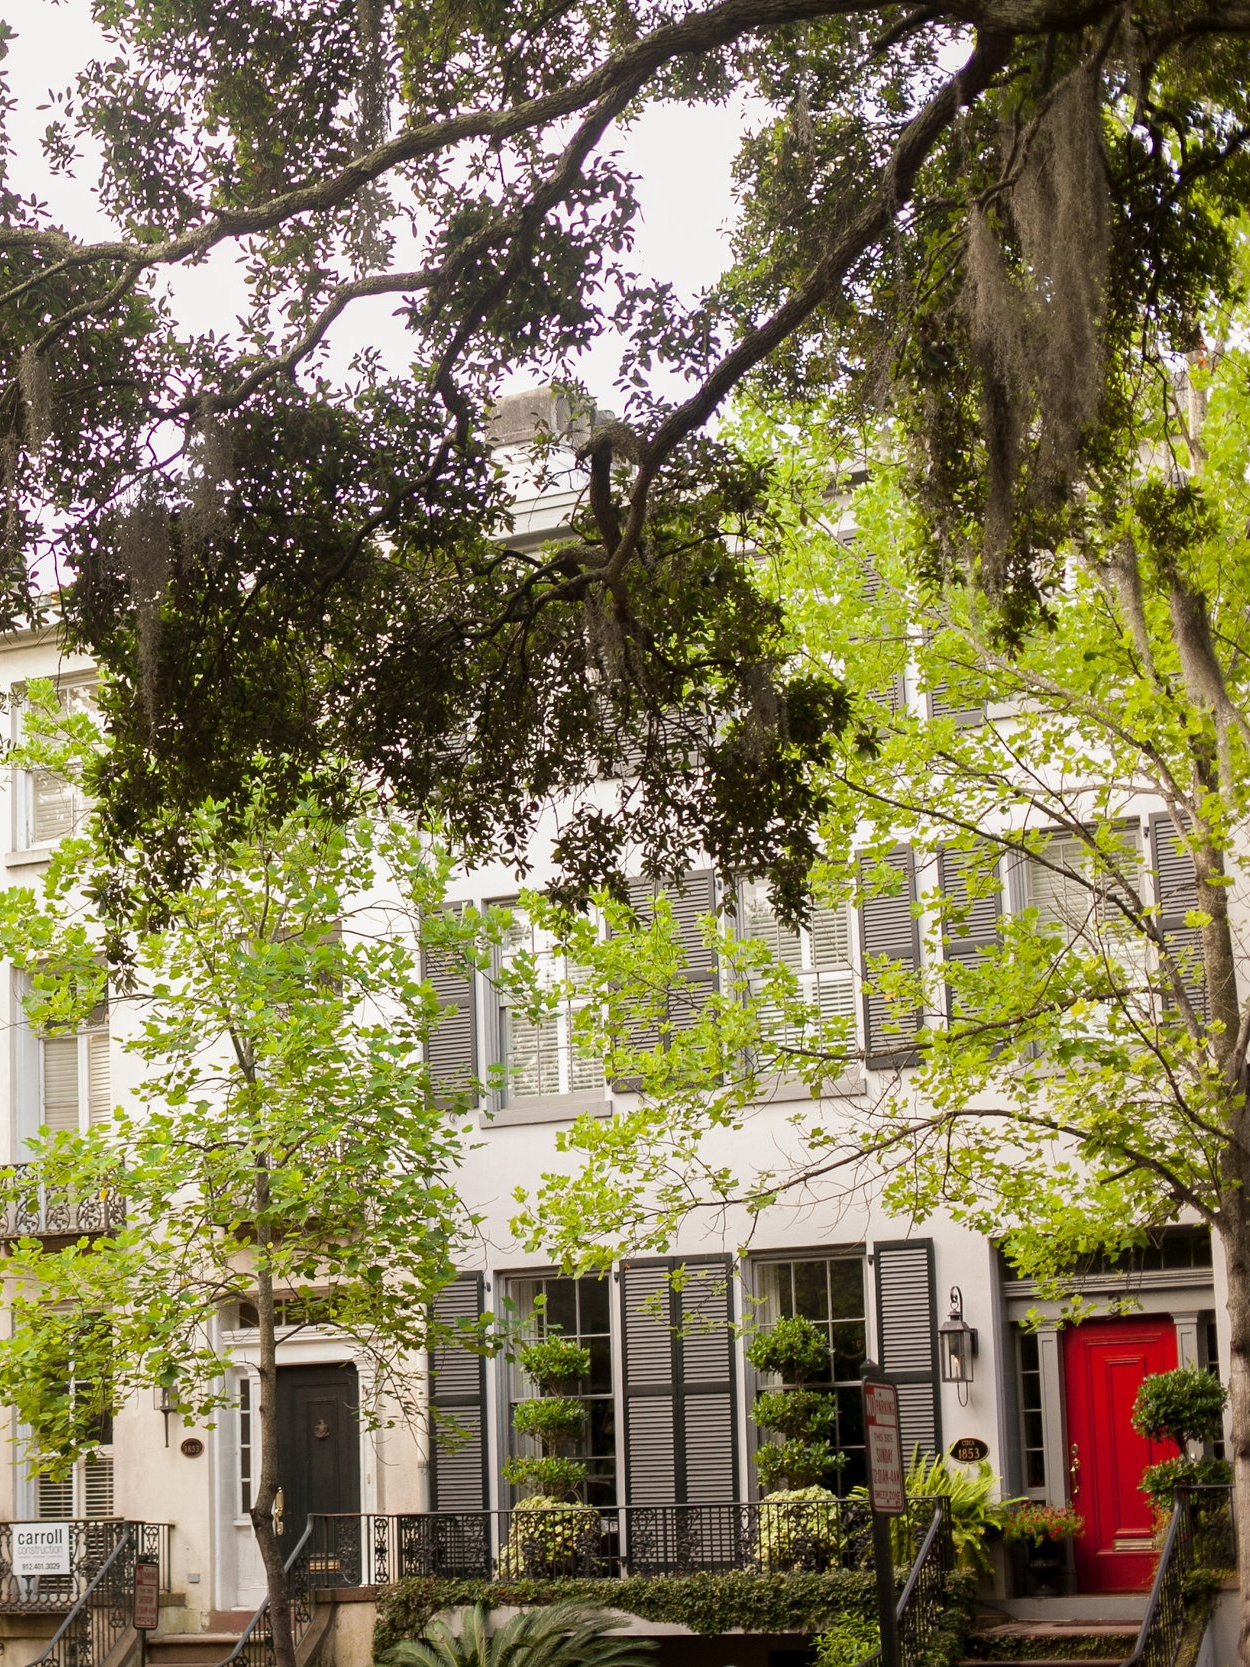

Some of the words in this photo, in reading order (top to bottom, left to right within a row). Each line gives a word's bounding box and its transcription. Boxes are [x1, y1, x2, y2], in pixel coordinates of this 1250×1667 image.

[875, 1400, 895, 1416] PARKING
[958, 1447, 980, 1459] 1853
[18, 1529, 62, 1545] carroll
[17, 1546, 63, 1555] construction
